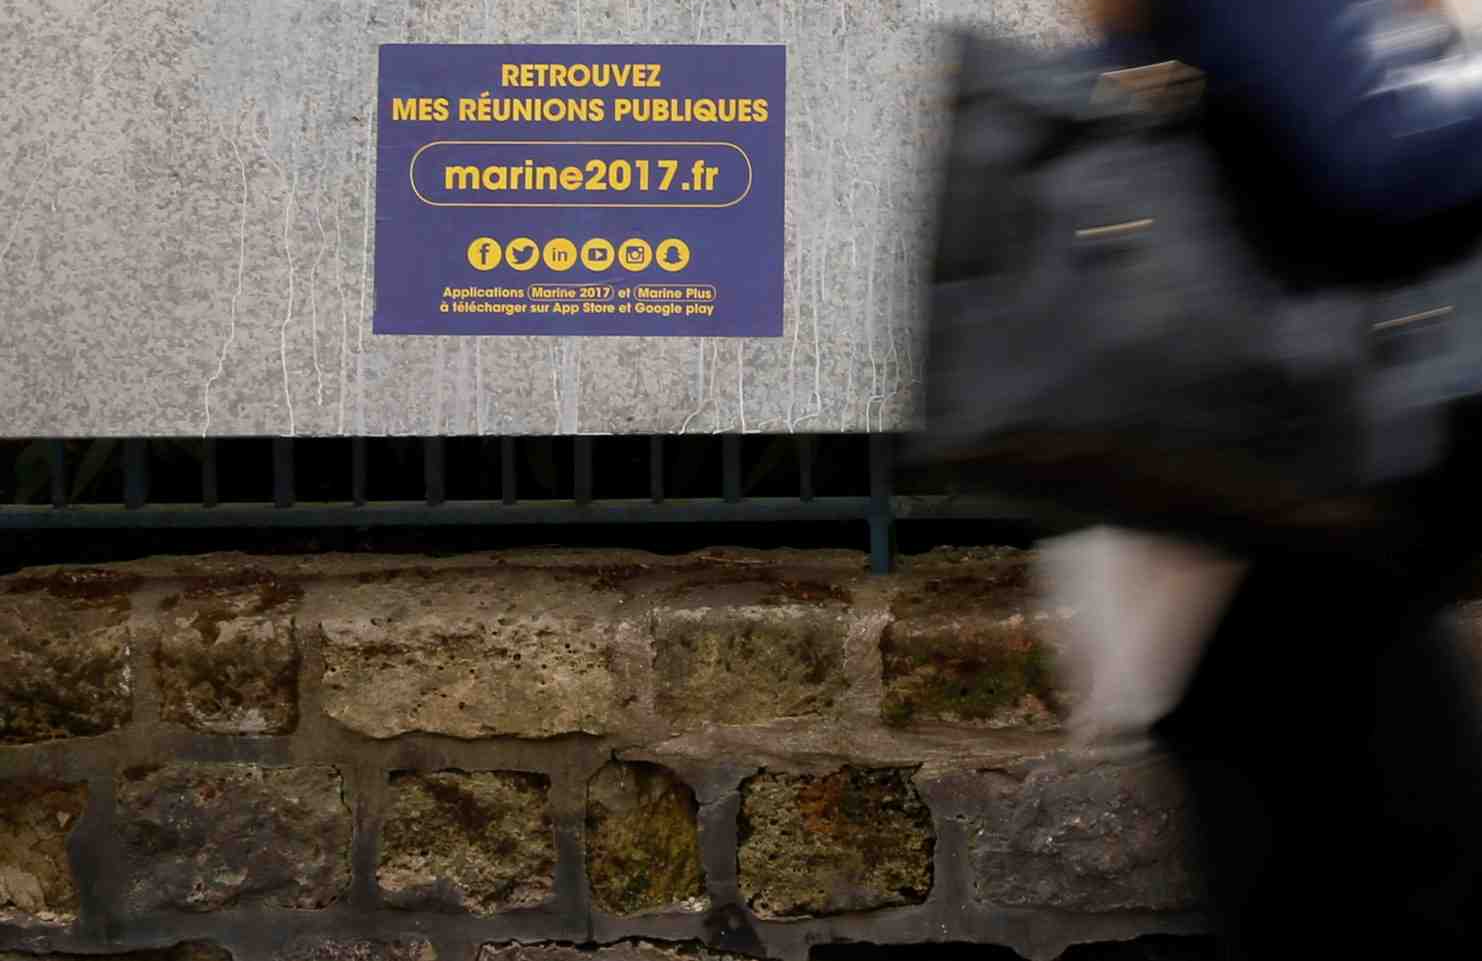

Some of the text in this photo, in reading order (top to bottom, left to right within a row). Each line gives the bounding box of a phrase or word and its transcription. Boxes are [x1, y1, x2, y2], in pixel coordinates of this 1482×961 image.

[501, 63, 662, 88] RETROUVEZ
[392, 92, 769, 123] MES RÉUNIONS PUBLIQUES
[444, 159, 719, 192] marine2017.fr
[442, 286, 712, 300] Applications Marine 2017 et Marine Plus
[452, 302, 527, 316] télécharger
[530, 304, 549, 313] sur
[552, 302, 580, 316] App
[582, 302, 615, 314] Store
[618, 303, 631, 313] et
[635, 302, 682, 317] Google
[685, 303, 714, 317] play
